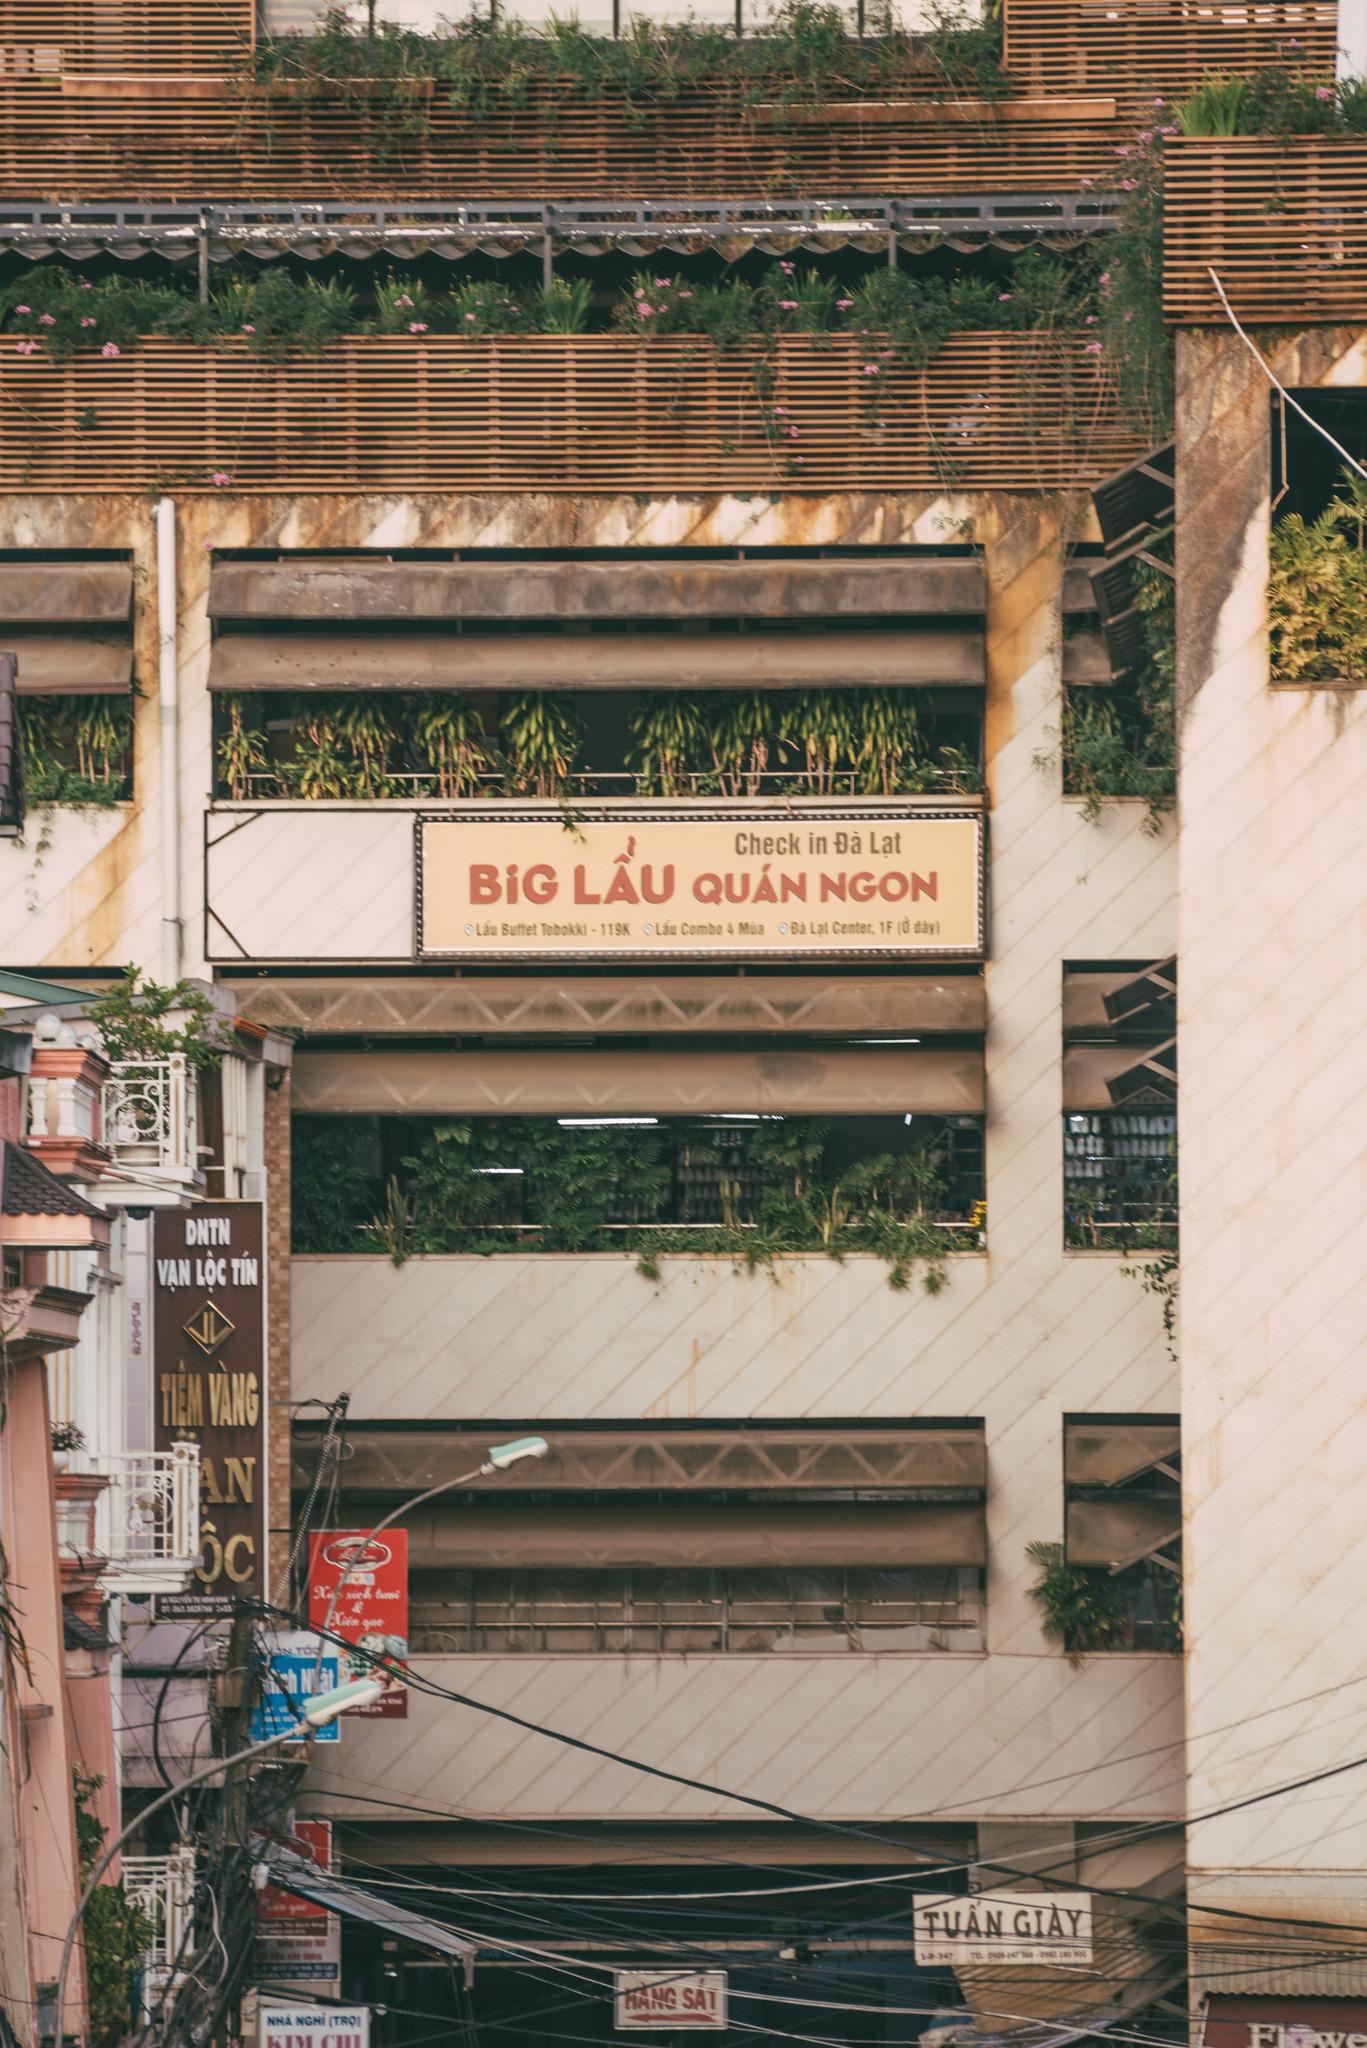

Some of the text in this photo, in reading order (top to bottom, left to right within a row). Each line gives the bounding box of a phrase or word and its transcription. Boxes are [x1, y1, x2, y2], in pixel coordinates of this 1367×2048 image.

[734, 830, 903, 858] Check in Đà Lạt
[469, 836, 939, 906] BiG LẨU QUÁN NGON
[500, 921, 538, 936] Buffet
[541, 921, 588, 936] Tobokki
[600, 922, 631, 936] 119K
[680, 921, 724, 936] Combo
[831, 920, 876, 936] Center,
[879, 921, 894, 935] 1F
[185, 1217, 232, 1246] DNTN
[156, 1249, 259, 1294] VẠN LỘC TÍN
[207, 1358, 260, 1428] VÀNG
[199, 1456, 257, 1515] ẠN
[195, 1519, 255, 1593] ỘC
[351, 1601, 364, 1614] &
[922, 1900, 1083, 1939] TUẤN GIÀY
[624, 1981, 677, 2010] HÀNG
[294, 2011, 327, 2026] NGHỈ
[328, 2014, 362, 2029] (TRỌ)
